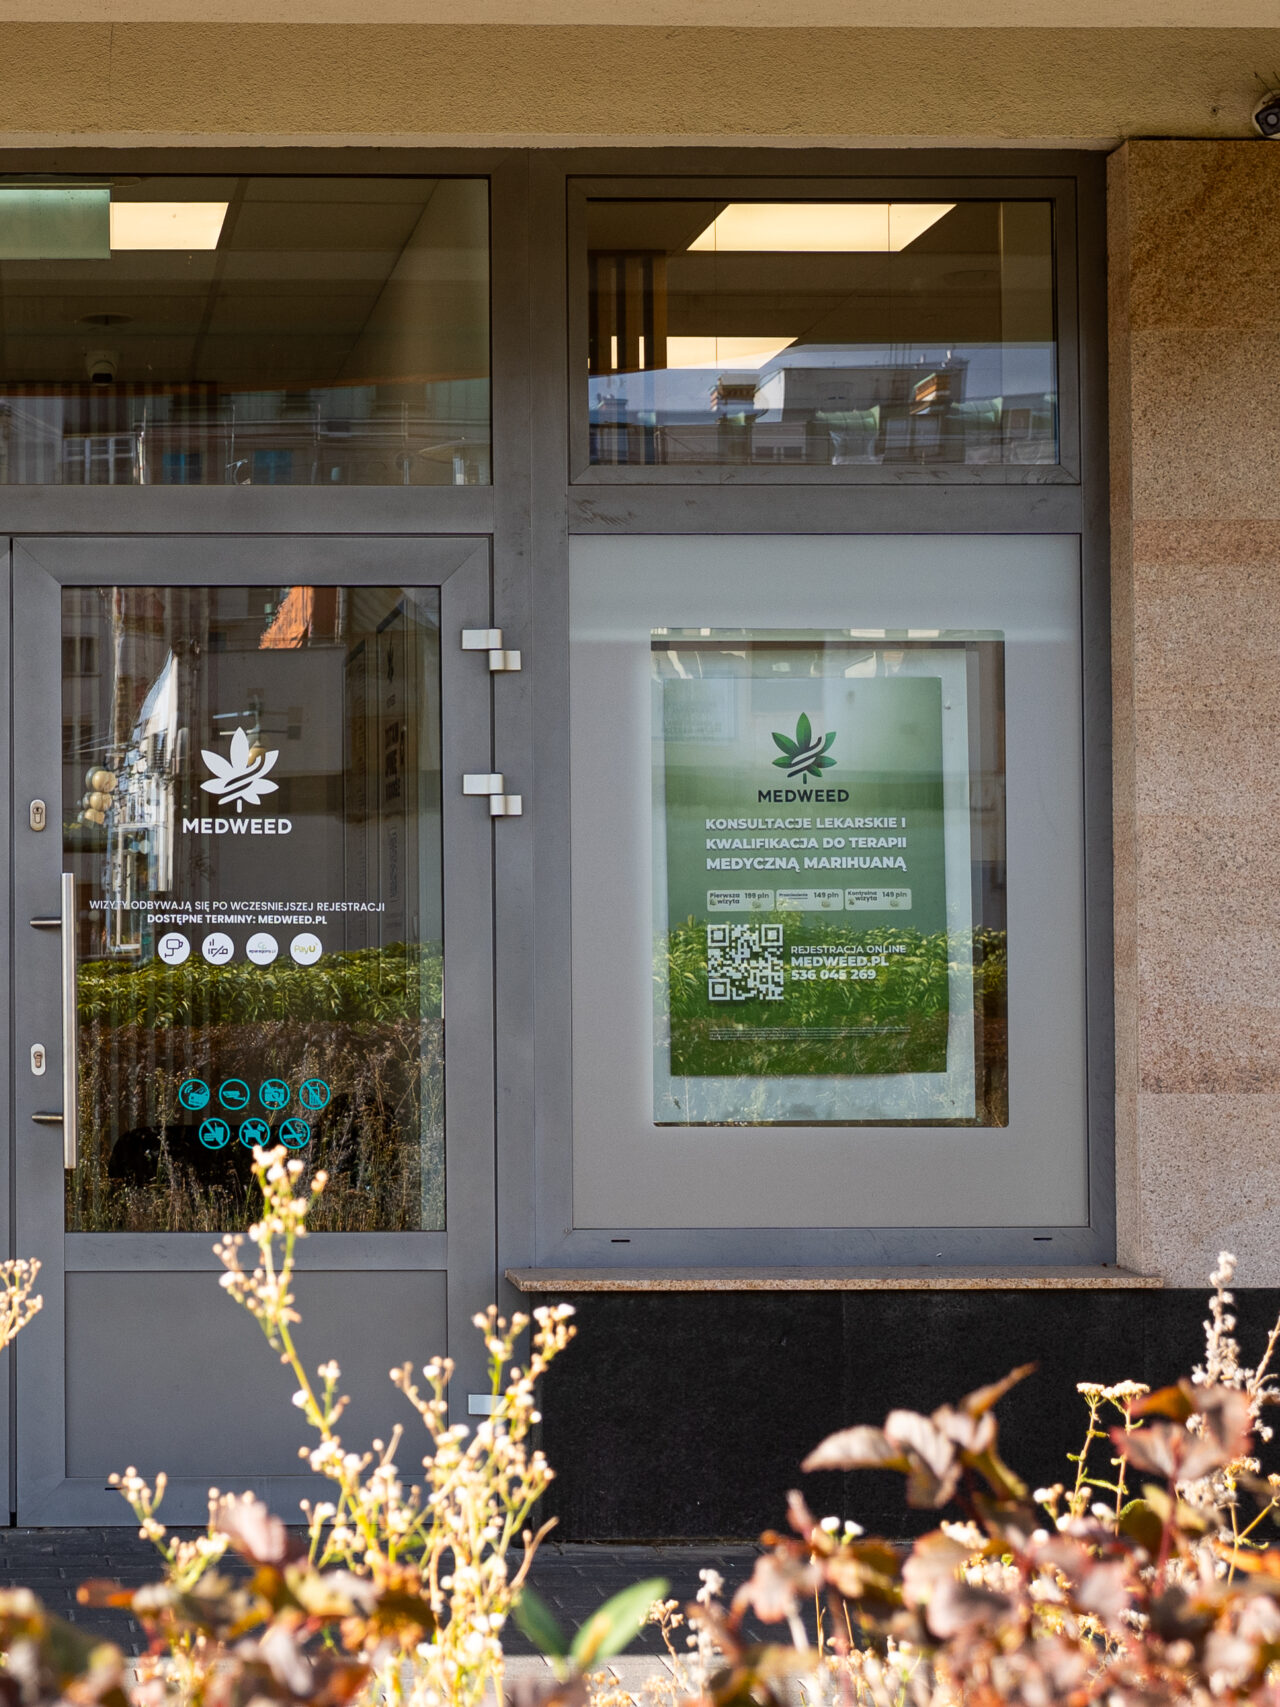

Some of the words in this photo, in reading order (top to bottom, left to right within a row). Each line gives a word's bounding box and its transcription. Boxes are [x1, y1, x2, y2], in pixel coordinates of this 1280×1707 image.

[757, 789, 850, 803] MEDWEED
[182, 817, 293, 835] MEDWEED
[705, 817, 812, 830] KONSULTACJE
[816, 817, 898, 829] LEKARSKIE
[901, 817, 906, 828] I
[706, 837, 819, 850] KWALIFIKACJA
[822, 837, 846, 849] DO
[848, 836, 907, 849] TERAPII
[706, 857, 801, 873] MEDYCZNĄ
[804, 856, 908, 872] MARIHUANĄ
[757, 892, 770, 900] pln
[813, 891, 826, 899] 149
[826, 891, 839, 900] pln
[882, 891, 894, 899] 149
[894, 891, 907, 899] pln
[89, 900, 129, 911] WIZYTY
[130, 900, 192, 912] ODBYWAJĄ
[194, 901, 210, 912] SIĘ
[212, 901, 228, 911] PO
[317, 902, 385, 912] REJESTRACJI
[147, 914, 204, 925] DOSTĘPNE
[205, 914, 256, 924] TERMINY:
[258, 915, 328, 925] MEDWEED.PL
[790, 945, 864, 954] REJESTRACJA
[866, 945, 907, 954] ONLINE
[791, 955, 889, 967] MEDWEED.PL
[791, 969, 817, 980] 536
[820, 969, 847, 980] 045
[850, 969, 877, 980] 269
